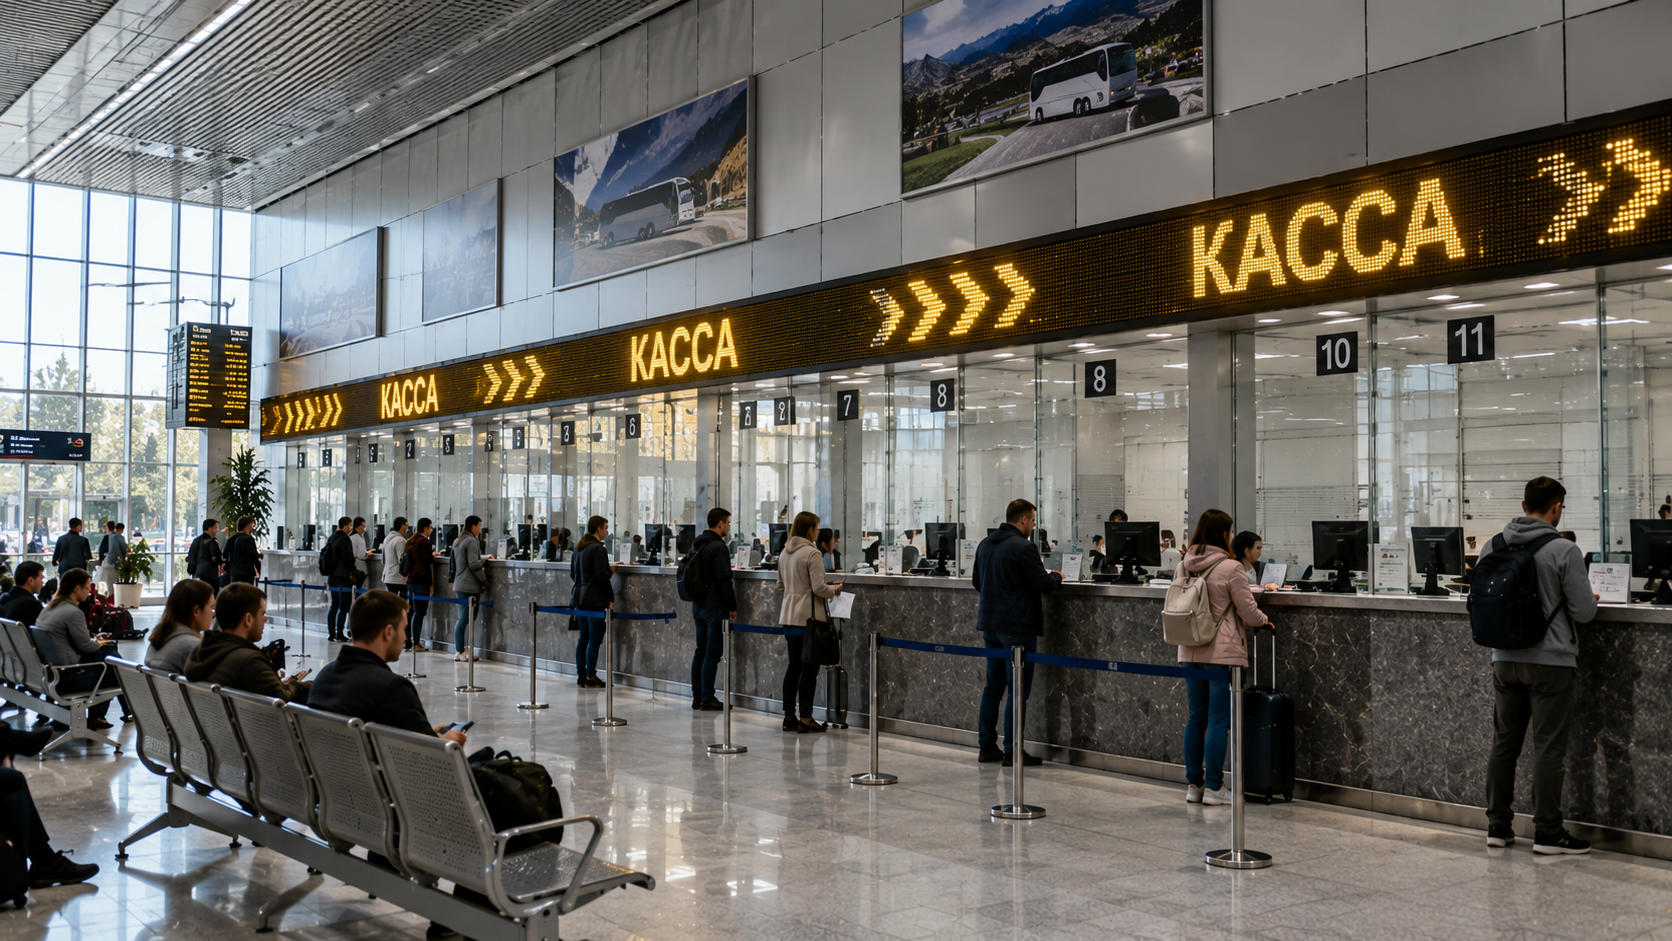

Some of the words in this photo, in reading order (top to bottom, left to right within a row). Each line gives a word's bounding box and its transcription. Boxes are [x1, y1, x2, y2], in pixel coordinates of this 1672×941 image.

[1193, 178, 1466, 298] КАССА
[630, 318, 739, 383] КАССА
[1321, 338, 1351, 370] 10
[1454, 322, 1483, 357] 11
[1093, 365, 1106, 393] 8
[380, 374, 439, 420] КАССА
[843, 394, 852, 417] 7
[937, 383, 947, 408] 8
[629, 417, 636, 436] 6
